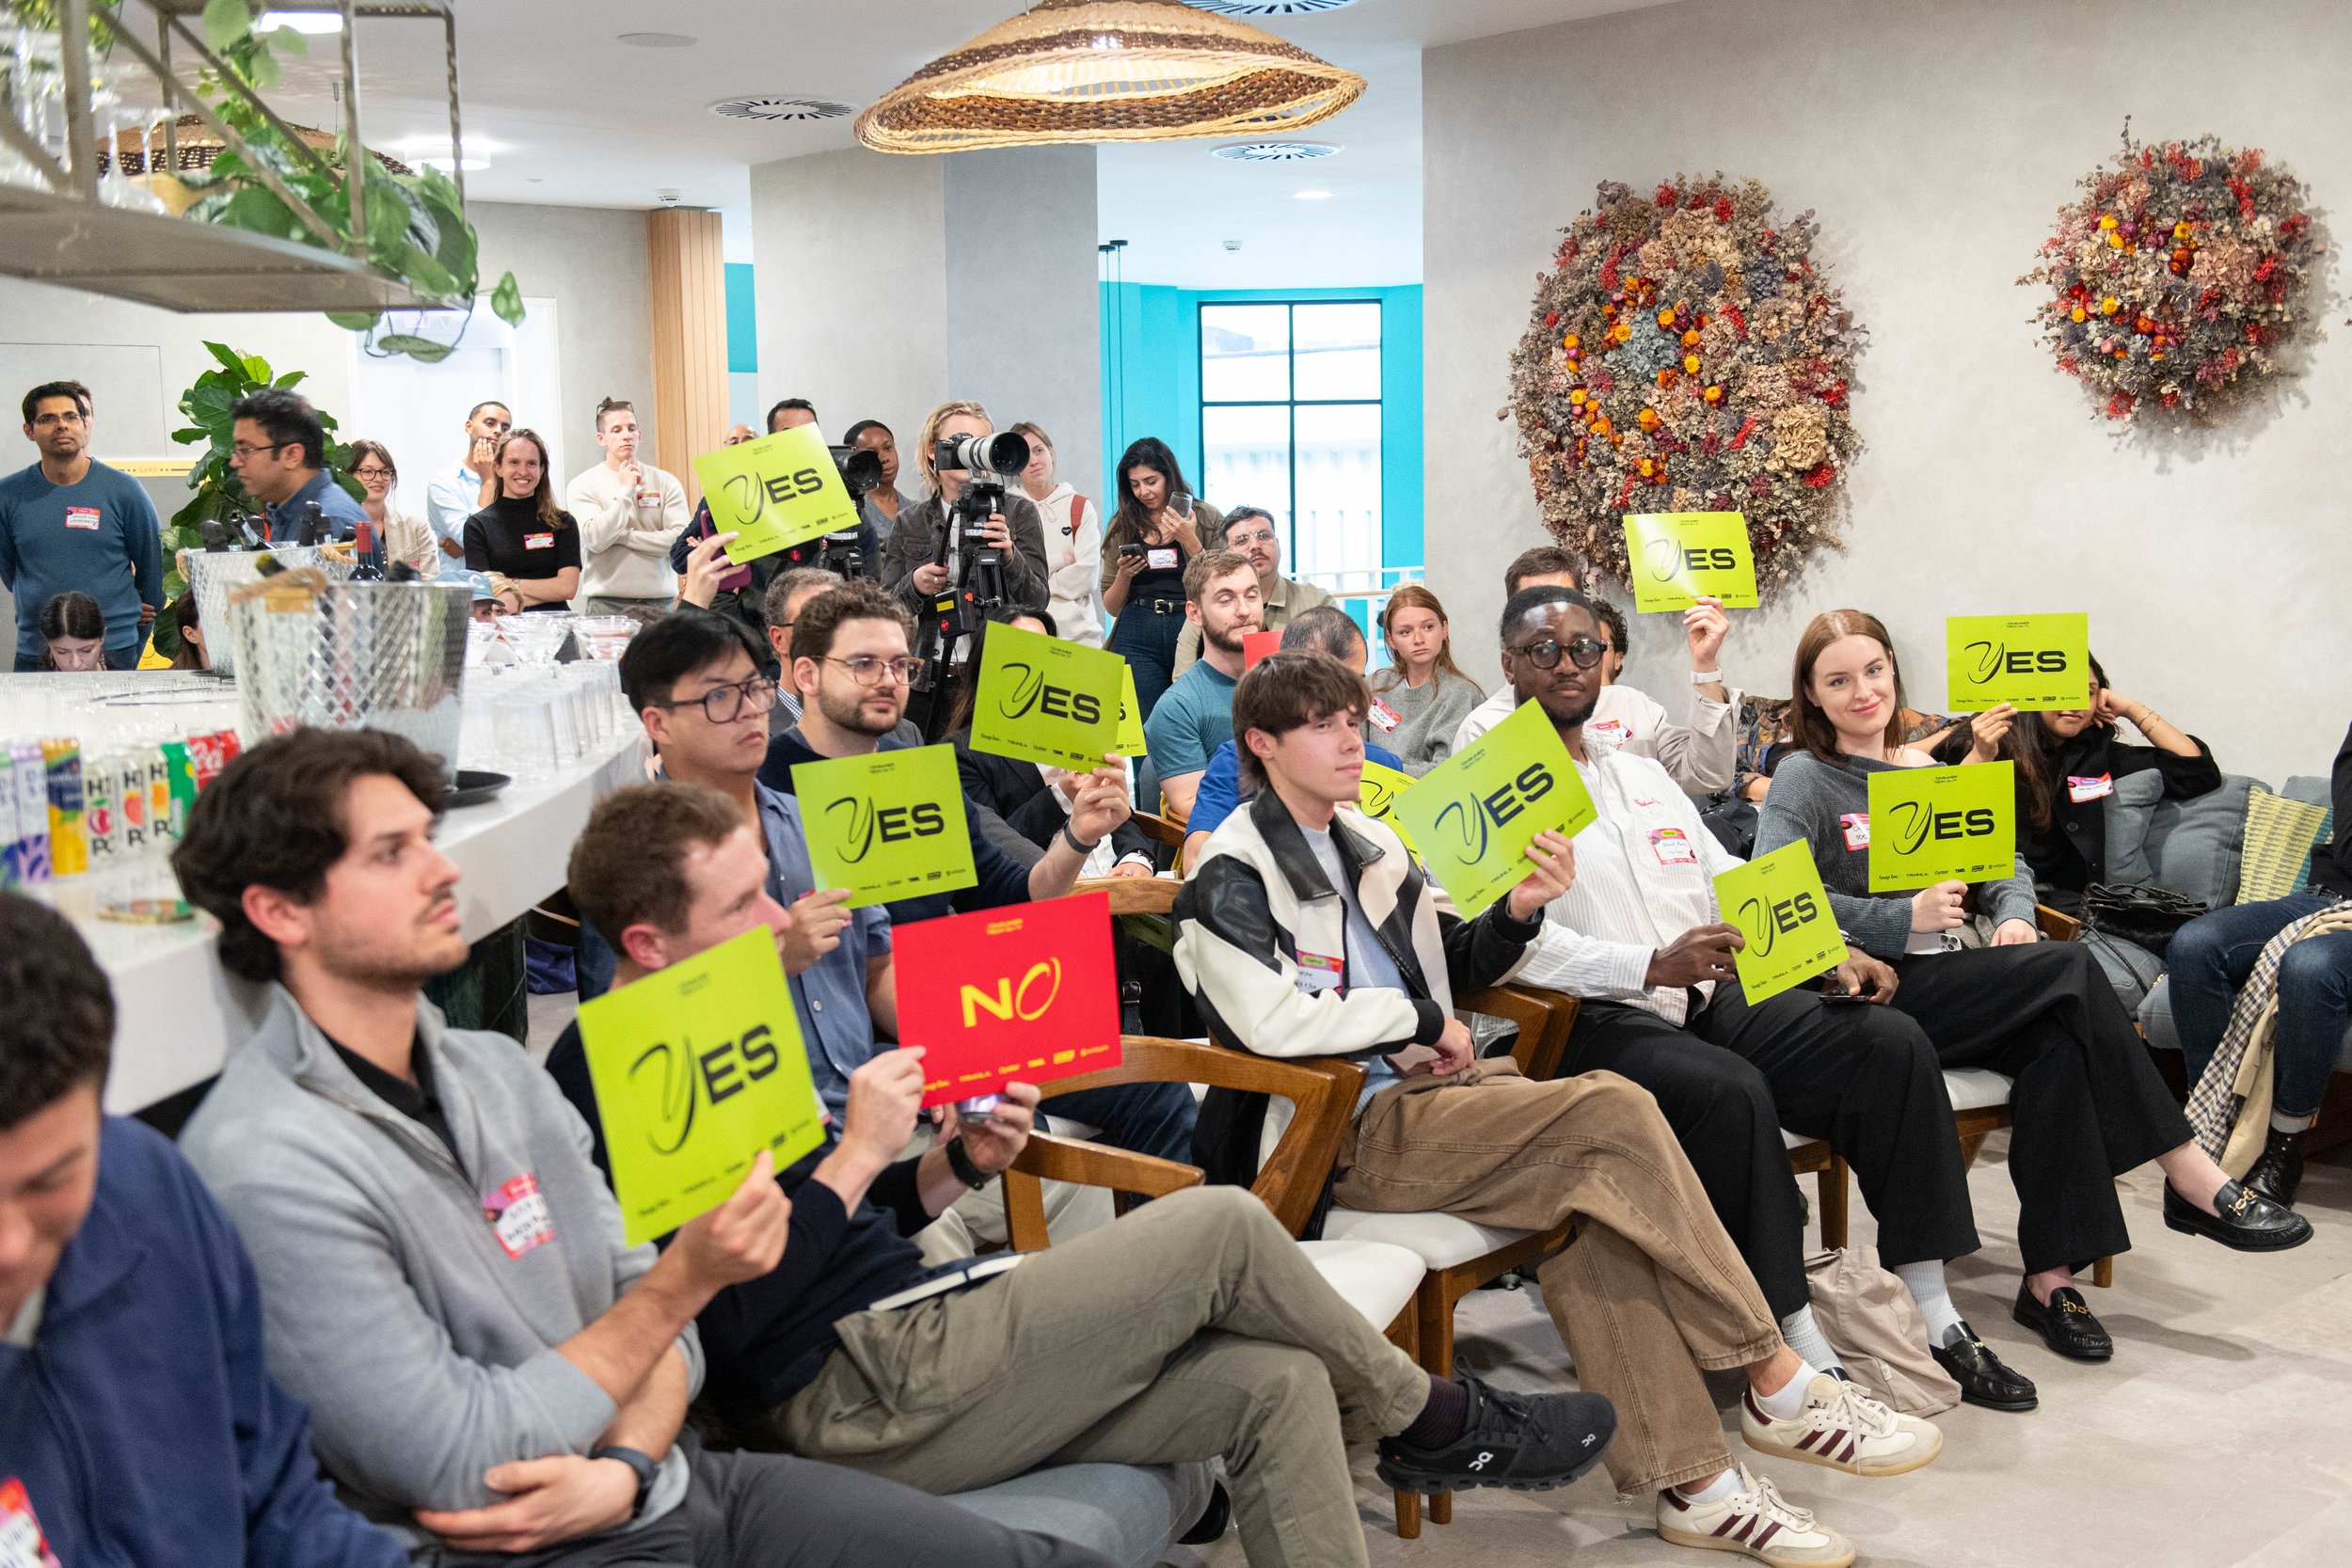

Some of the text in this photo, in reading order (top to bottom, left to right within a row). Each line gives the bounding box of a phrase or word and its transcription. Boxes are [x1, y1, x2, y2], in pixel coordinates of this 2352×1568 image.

[723, 467, 823, 525] YES
[1645, 538, 1736, 582] YES
[999, 662, 1101, 724] YES
[1963, 641, 2067, 684] YES
[824, 795, 945, 863] YES
[1435, 763, 1554, 865] YES
[1889, 800, 1994, 855] YES
[1739, 892, 1818, 958] YES
[960, 957, 1061, 1028] NO
[628, 1023, 779, 1155] YES
